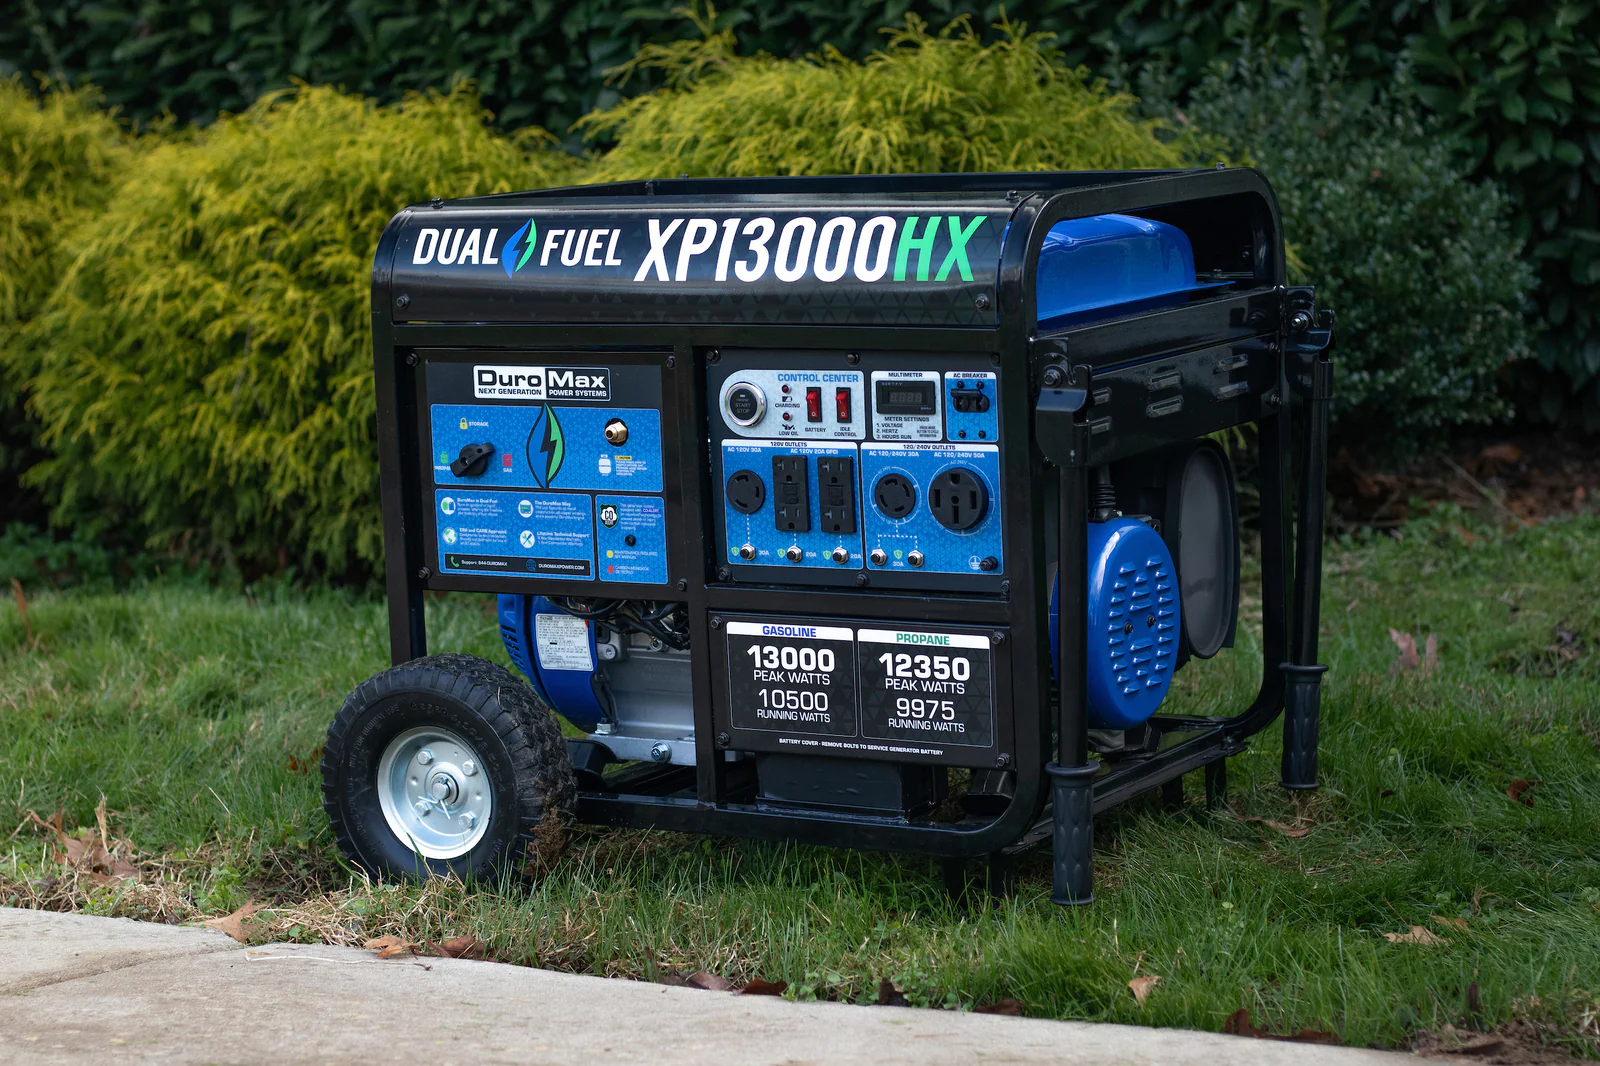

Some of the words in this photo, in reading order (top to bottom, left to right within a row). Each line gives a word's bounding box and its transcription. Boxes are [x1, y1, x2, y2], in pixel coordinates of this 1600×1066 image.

[412, 228, 499, 266] DUAL
[540, 229, 622, 267] FUEL
[633, 215, 988, 284] XP13000HX
[778, 374, 820, 382] CONTROL
[822, 374, 858, 382] CENTER
[498, 388, 542, 396] GENERATION
[604, 510, 614, 520] CO
[762, 626, 816, 637] GASOLINE
[896, 633, 950, 645] PROPANE
[747, 644, 835, 673] 13000
[878, 653, 970, 682] 12350
[754, 671, 786, 683] PEAK
[788, 673, 830, 685] WATTS
[886, 678, 918, 691] PEAK
[921, 681, 965, 694] WATTS
[758, 688, 828, 712] 10500
[757, 709, 798, 721] RUNNING
[800, 712, 831, 723] WATTS
[896, 698, 955, 720] 9975
[354, 734, 365, 750] FOR
[385, 704, 400, 715] USE
[888, 718, 931, 731] RUNNING
[933, 721, 965, 733] WATTS
